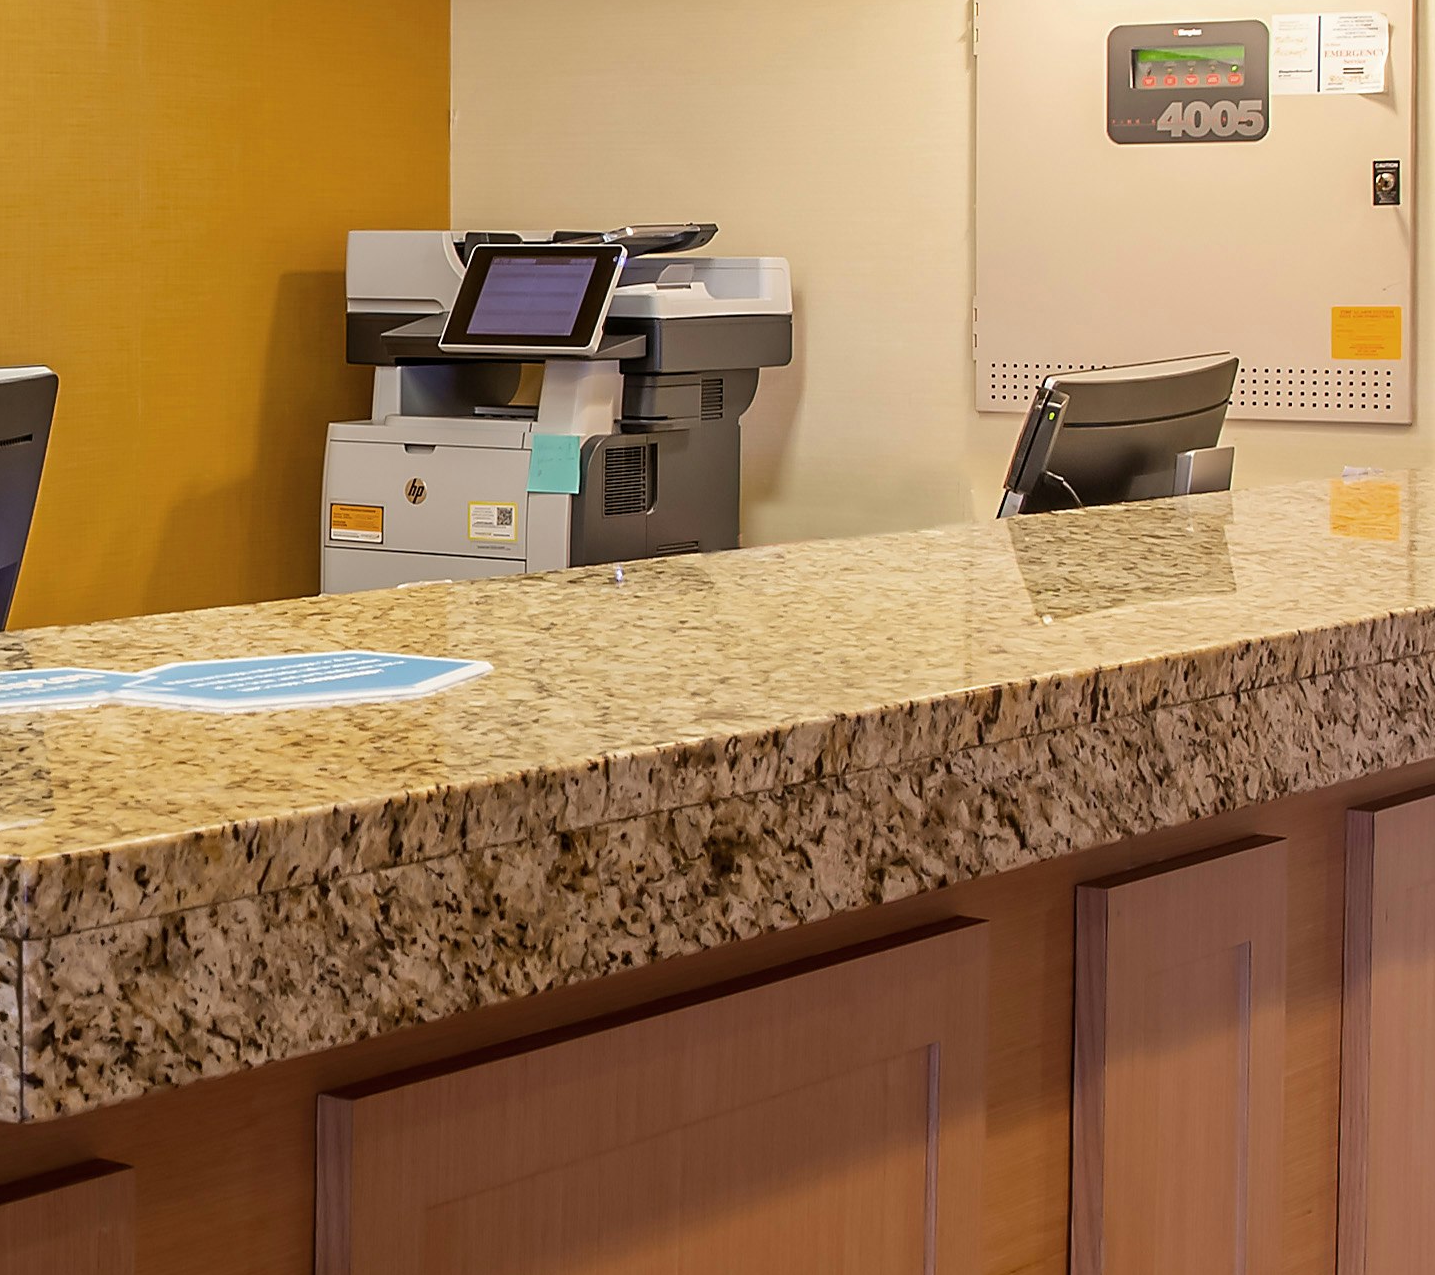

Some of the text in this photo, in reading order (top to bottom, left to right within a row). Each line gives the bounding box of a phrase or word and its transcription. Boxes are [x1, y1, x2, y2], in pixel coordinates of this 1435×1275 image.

[1323, 47, 1384, 58] EMERGENCY
[1156, 99, 1265, 137] 4005
[407, 477, 425, 504] hp
